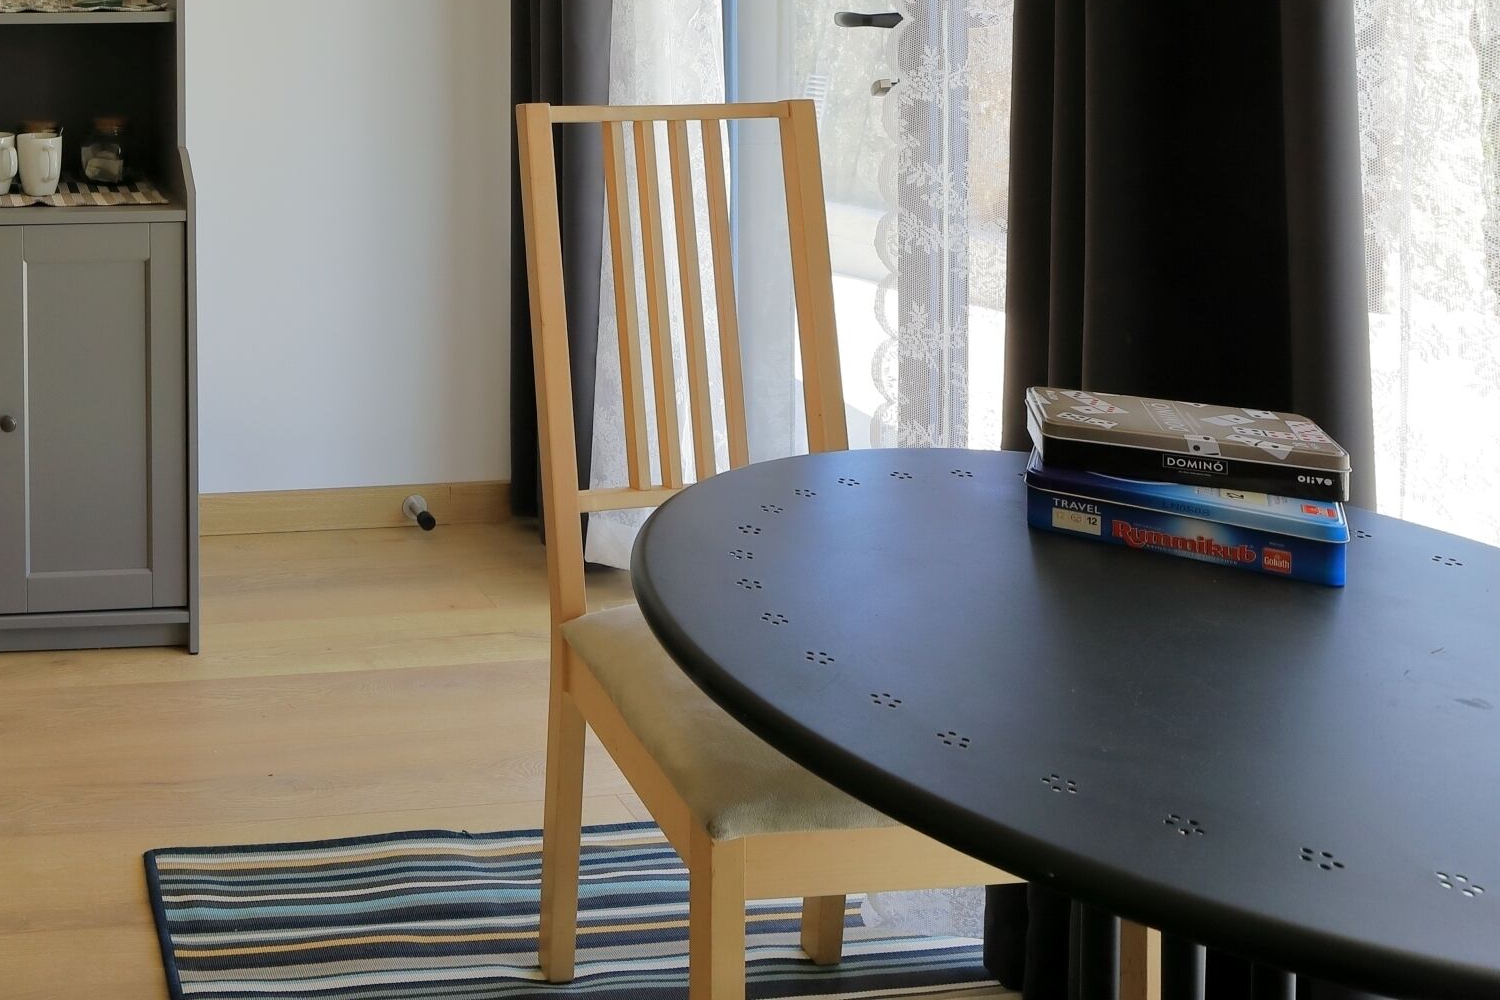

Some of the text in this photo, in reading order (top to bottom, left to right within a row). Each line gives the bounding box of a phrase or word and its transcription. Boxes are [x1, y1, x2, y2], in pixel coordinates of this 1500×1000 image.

[1167, 457, 1223, 472] DOMINÓ
[1052, 497, 1102, 514] TRAVEL
[1087, 516, 1098, 526] 12
[1111, 519, 1257, 564] Rummikub
[1264, 556, 1290, 569] Goliath
